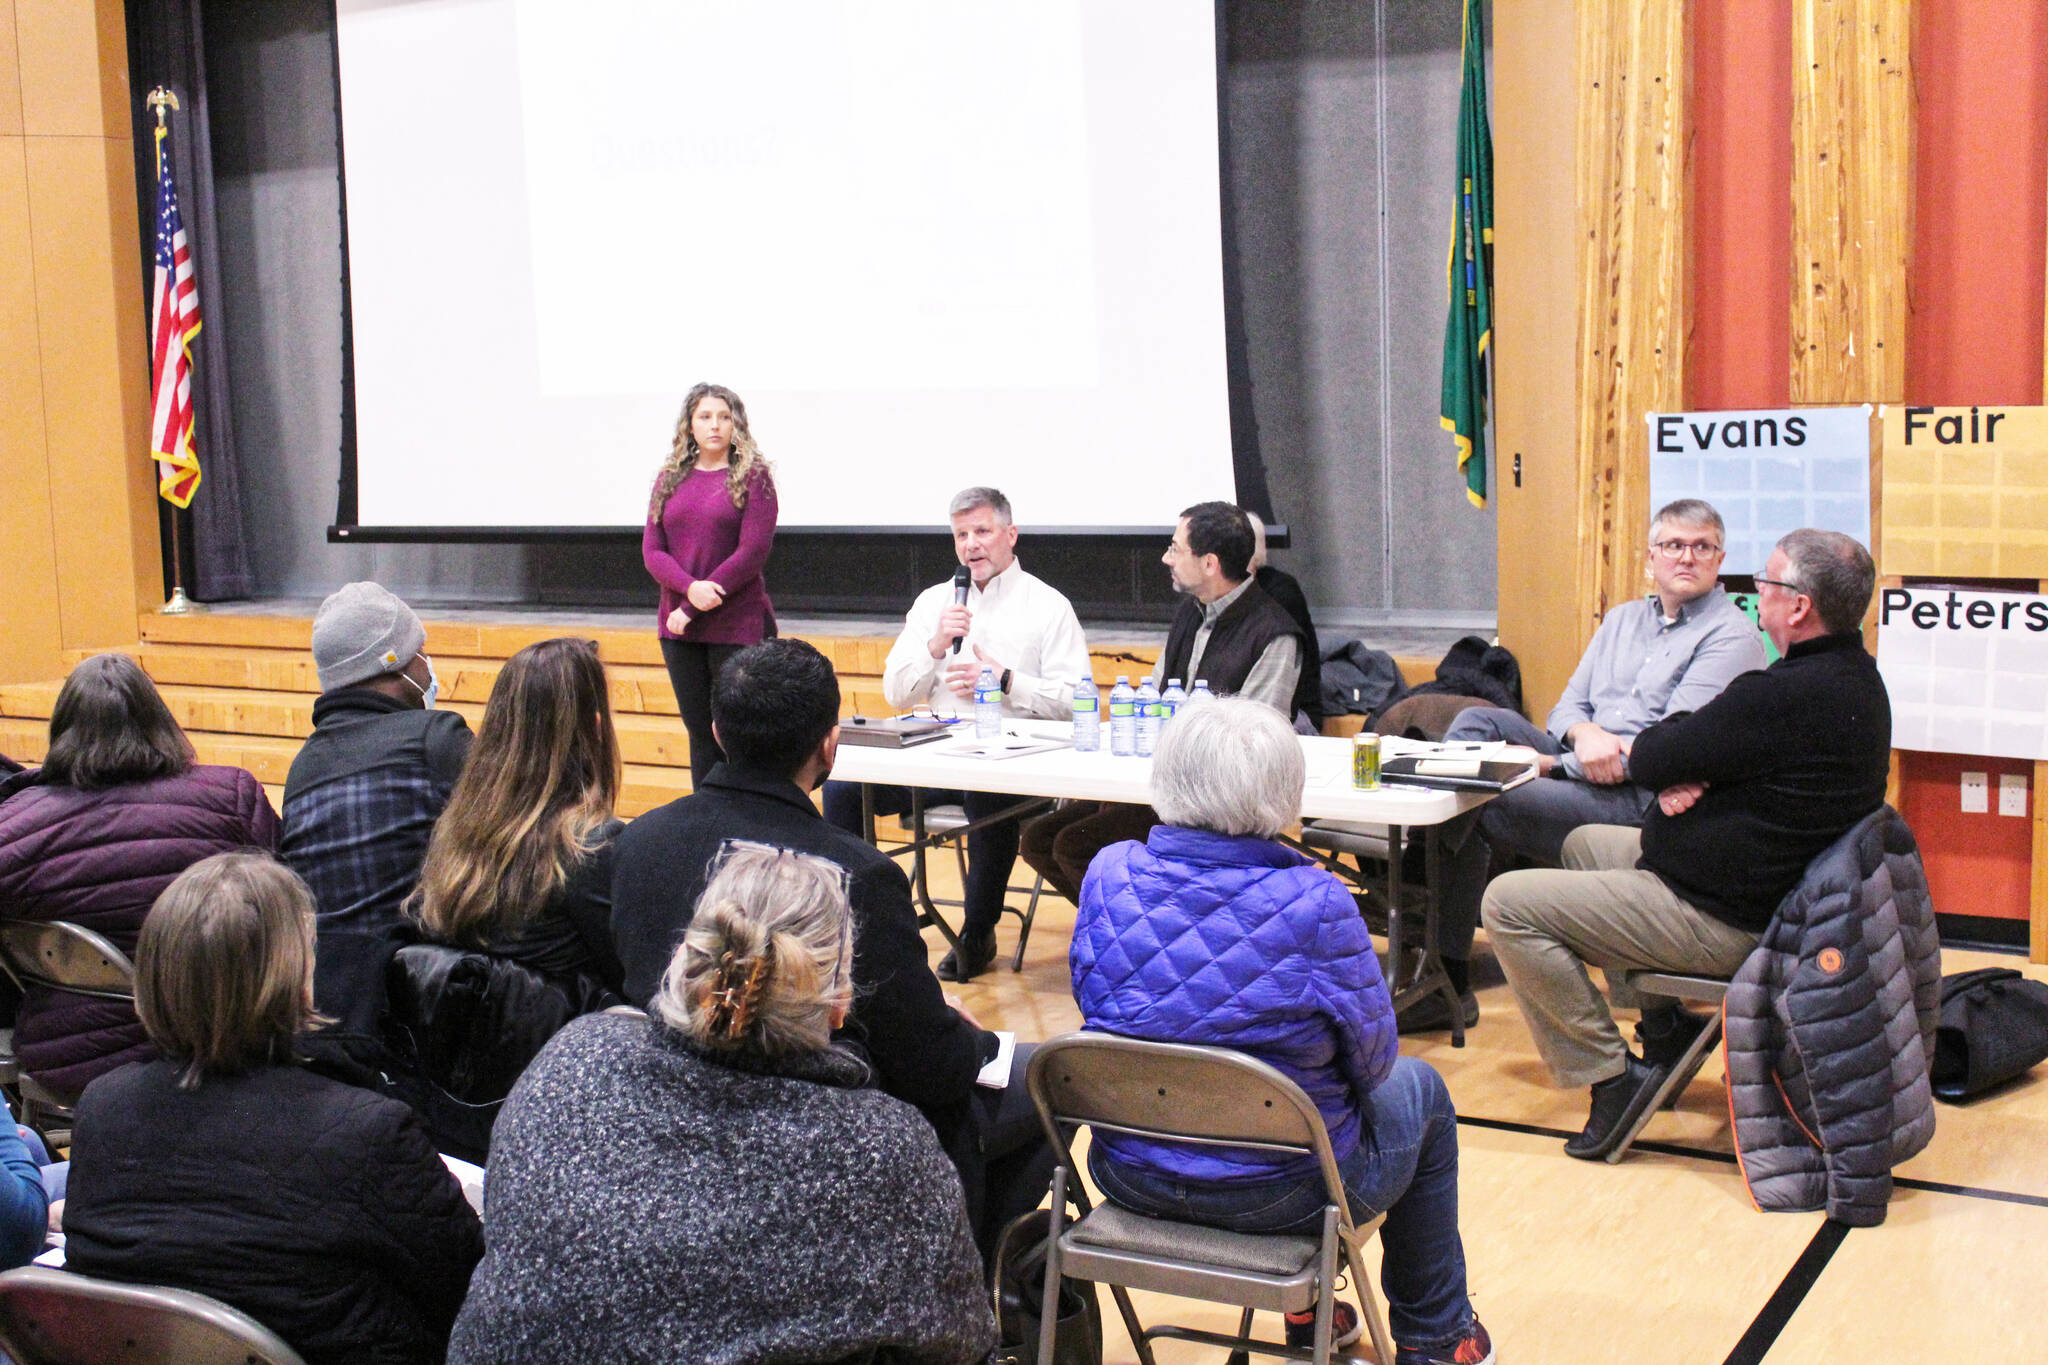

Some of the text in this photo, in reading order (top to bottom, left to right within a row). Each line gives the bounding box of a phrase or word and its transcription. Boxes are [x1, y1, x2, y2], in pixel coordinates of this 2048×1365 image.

[1656, 416, 1808, 453] Evans
[1904, 406, 2006, 446] Fair
[1881, 587, 2048, 632] Peters
